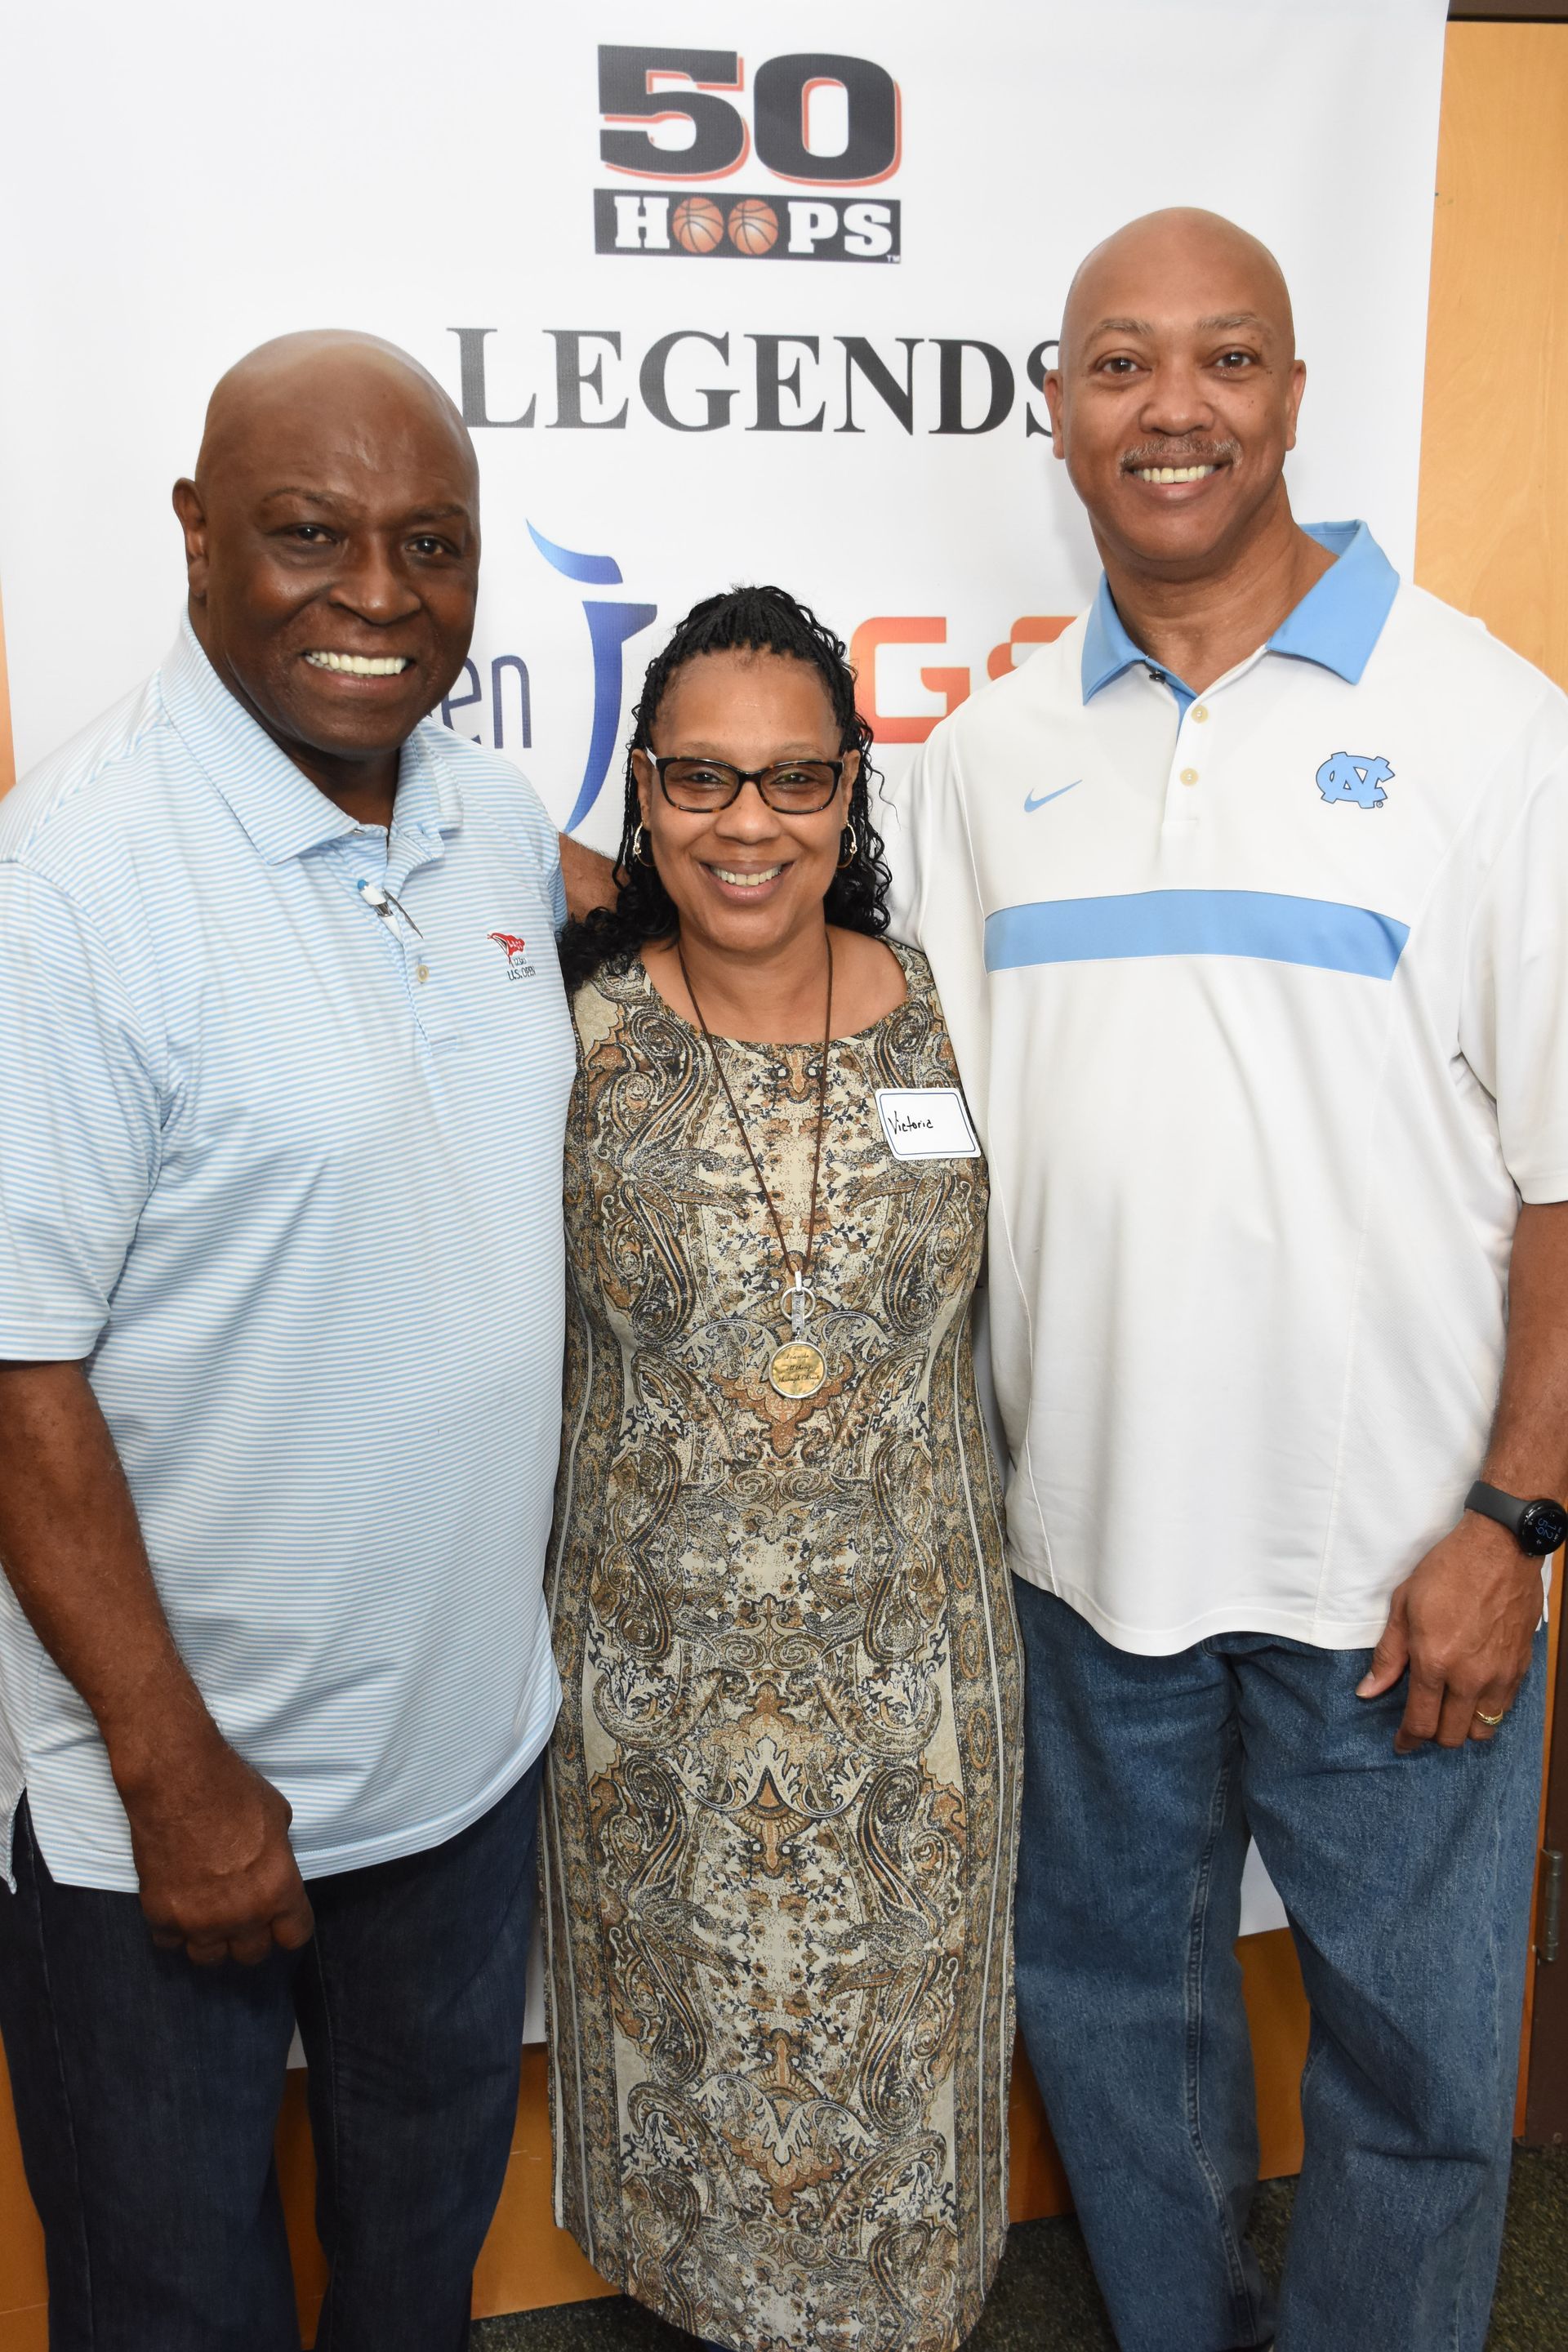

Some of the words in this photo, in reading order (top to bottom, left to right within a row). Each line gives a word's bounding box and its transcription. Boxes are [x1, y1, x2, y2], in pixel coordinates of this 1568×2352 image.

[598, 44, 902, 187] 50
[614, 196, 893, 256] HOOPS
[887, 1110, 933, 1135] Victoria
